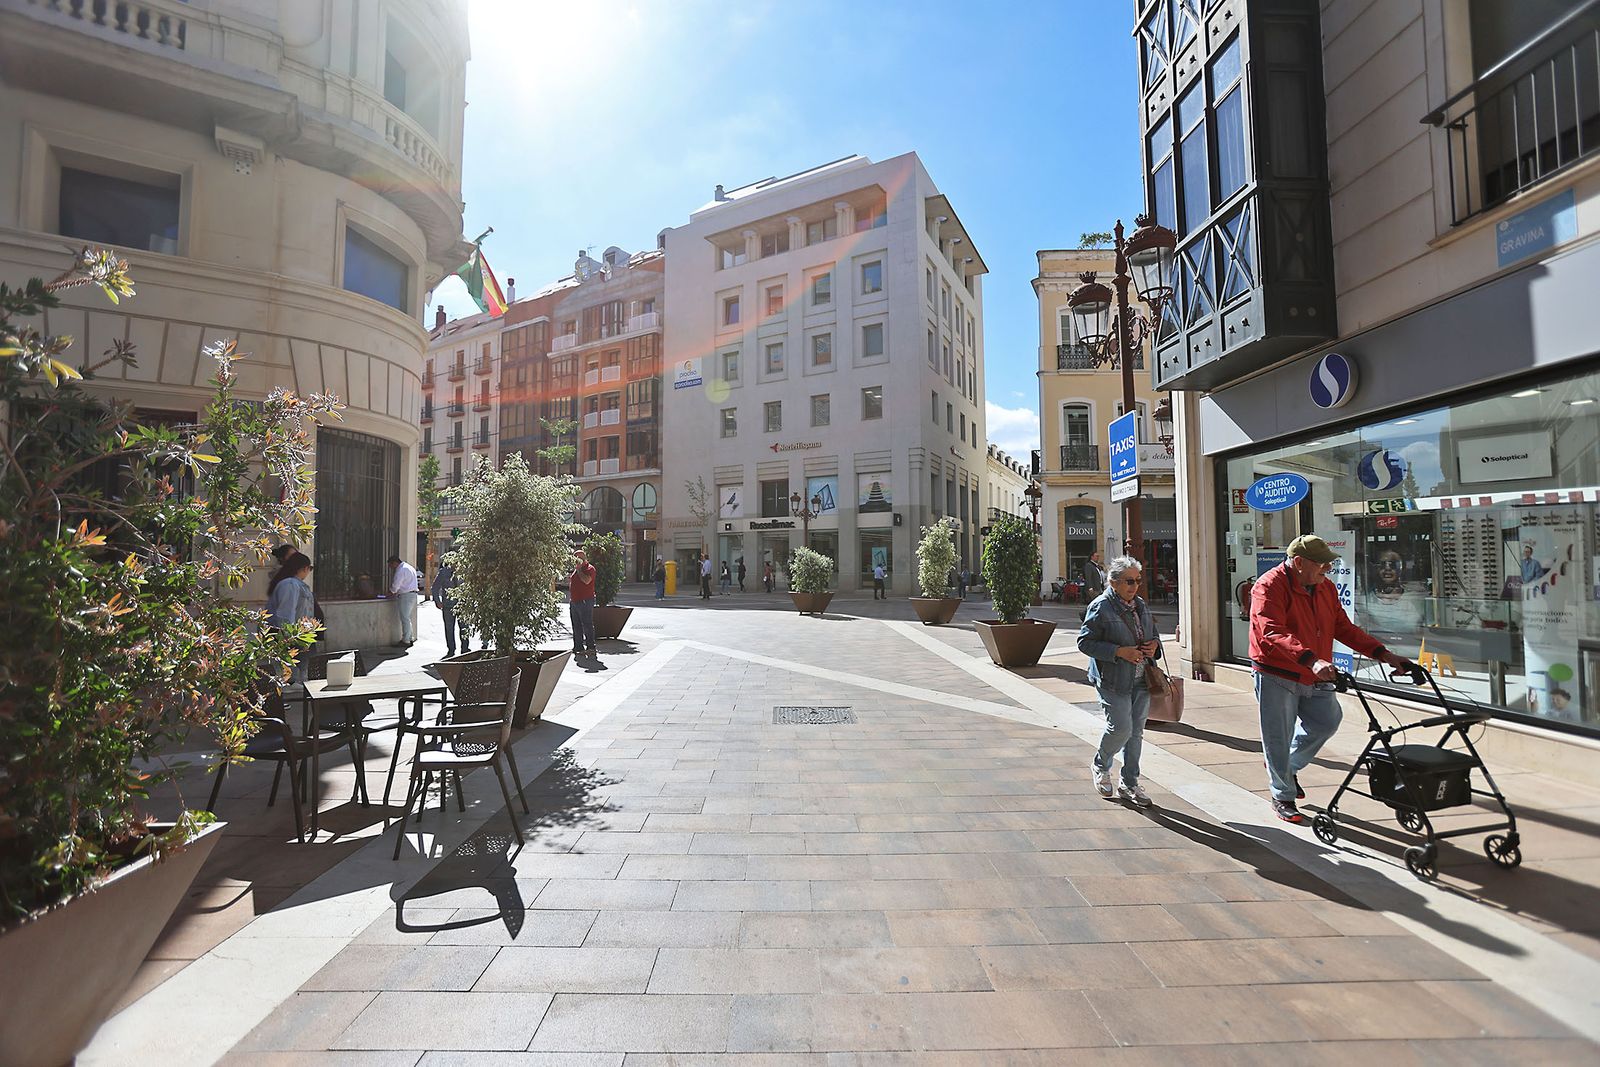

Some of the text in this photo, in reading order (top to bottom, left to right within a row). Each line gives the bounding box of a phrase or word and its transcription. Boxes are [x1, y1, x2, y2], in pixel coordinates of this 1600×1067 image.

[1500, 226, 1545, 254] GRAVINA
[1110, 435, 1135, 456] TAXIS
[1490, 453, 1528, 462] Soloptical
[1263, 478, 1290, 490] CENTRO
[1264, 485, 1297, 498] AUDITIVO
[1264, 496, 1287, 506] Soloptical
[1068, 526, 1094, 535] DIONI
